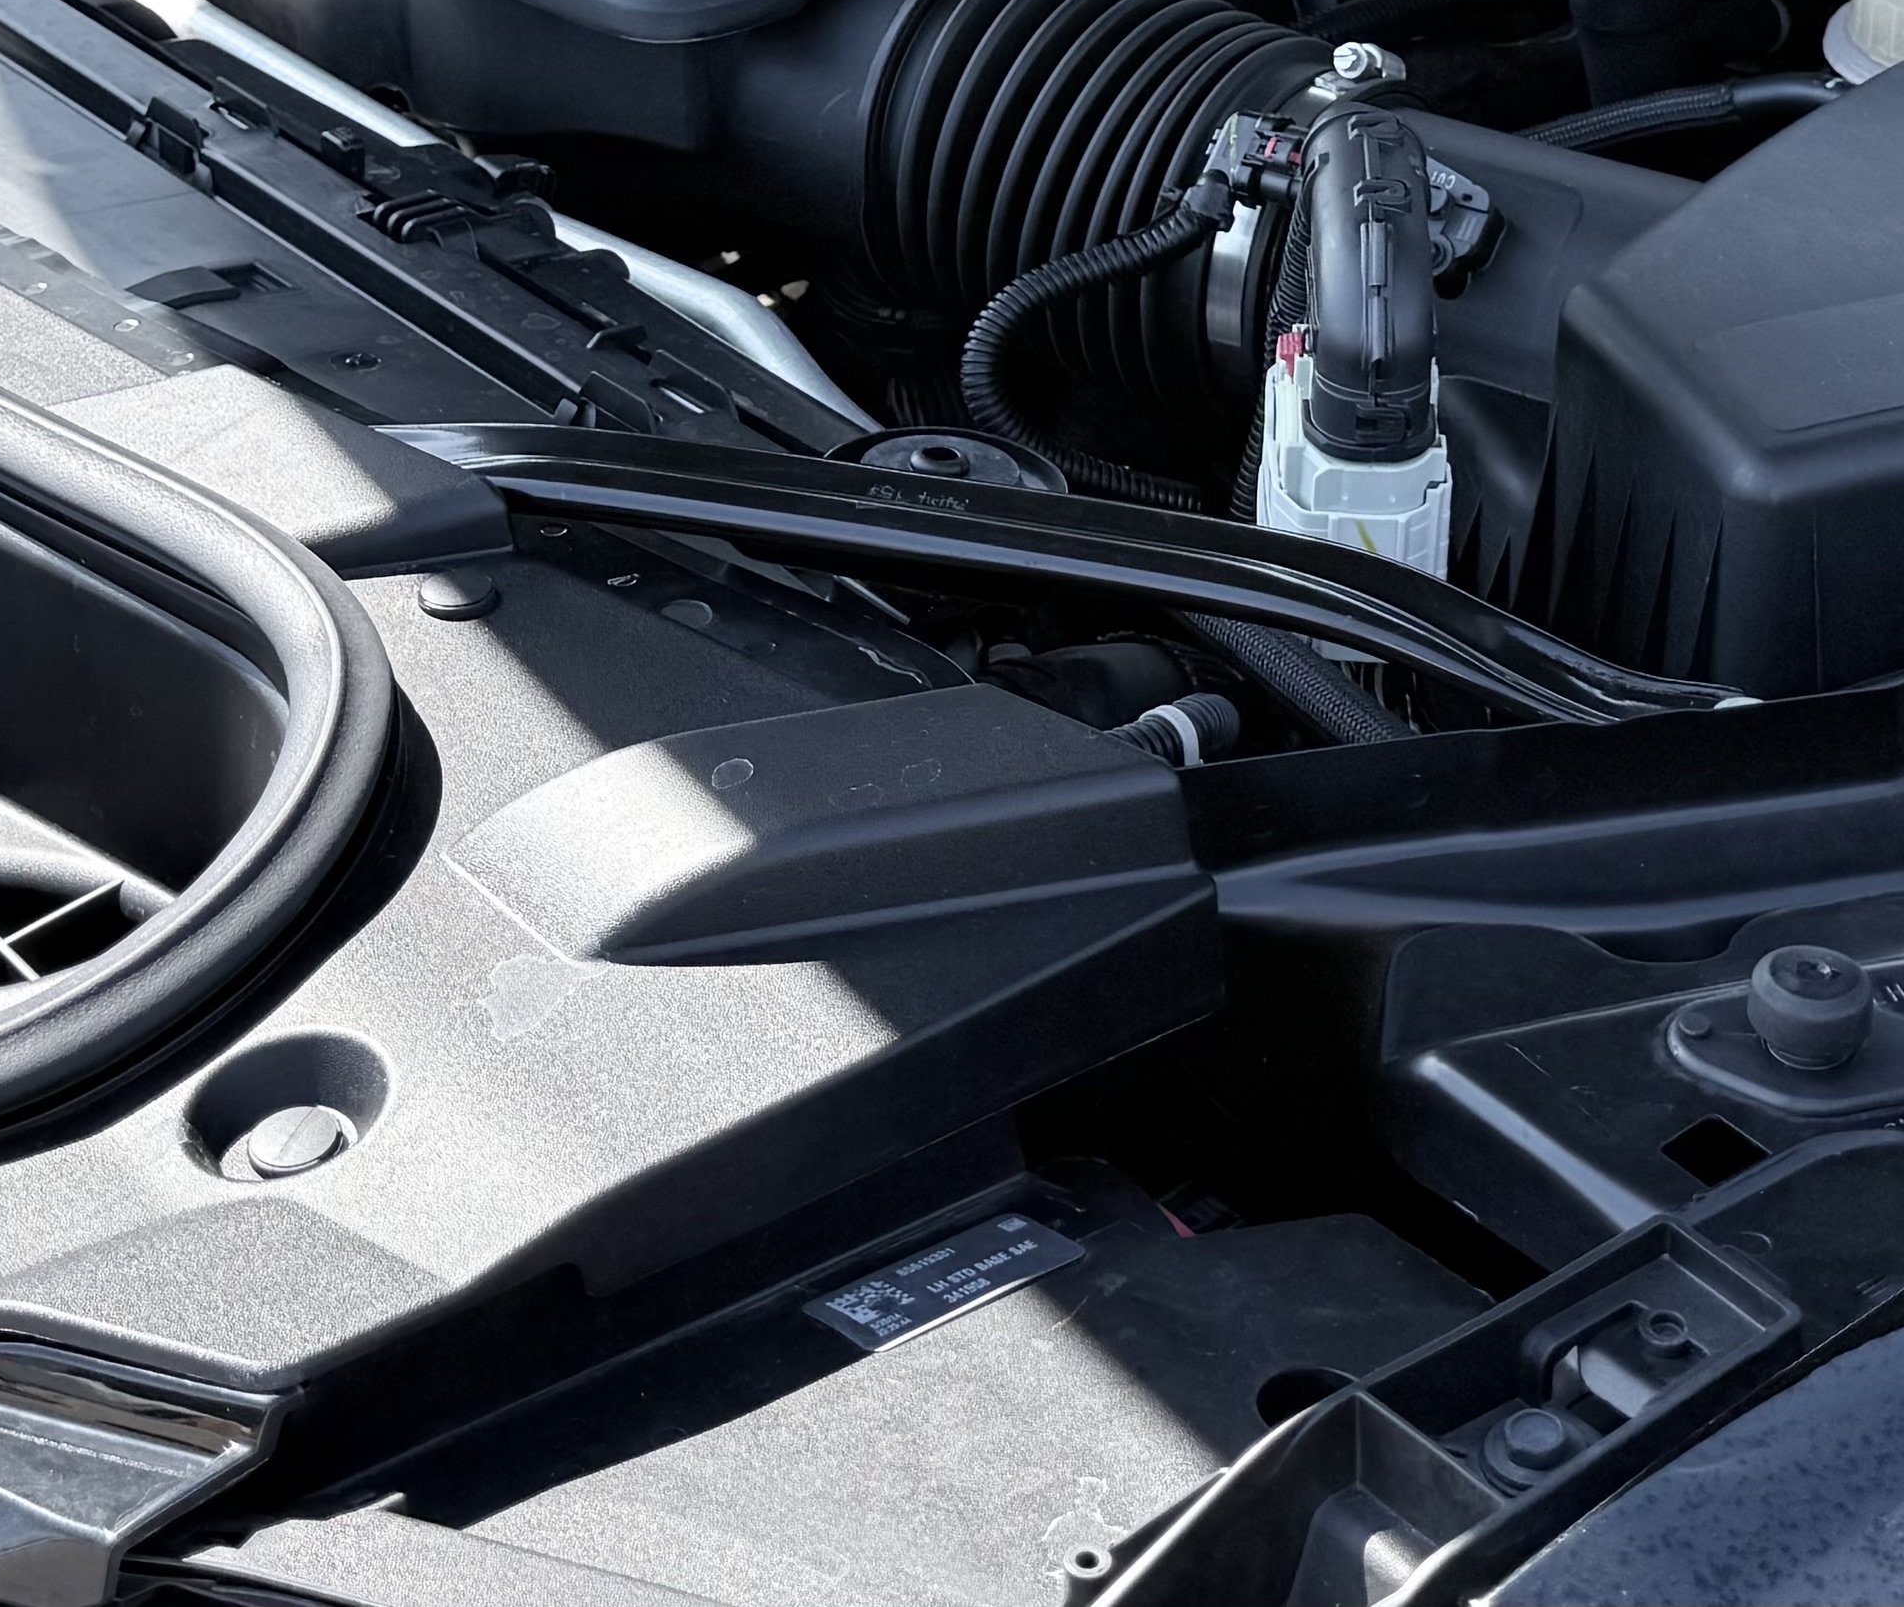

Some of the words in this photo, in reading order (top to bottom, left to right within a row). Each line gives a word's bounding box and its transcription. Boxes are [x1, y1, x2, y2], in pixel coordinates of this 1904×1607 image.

[926, 1278, 950, 1293] LH
[948, 1267, 974, 1284] STD
[973, 1251, 1012, 1272] BASE
[1008, 1239, 1039, 1256] SAE
